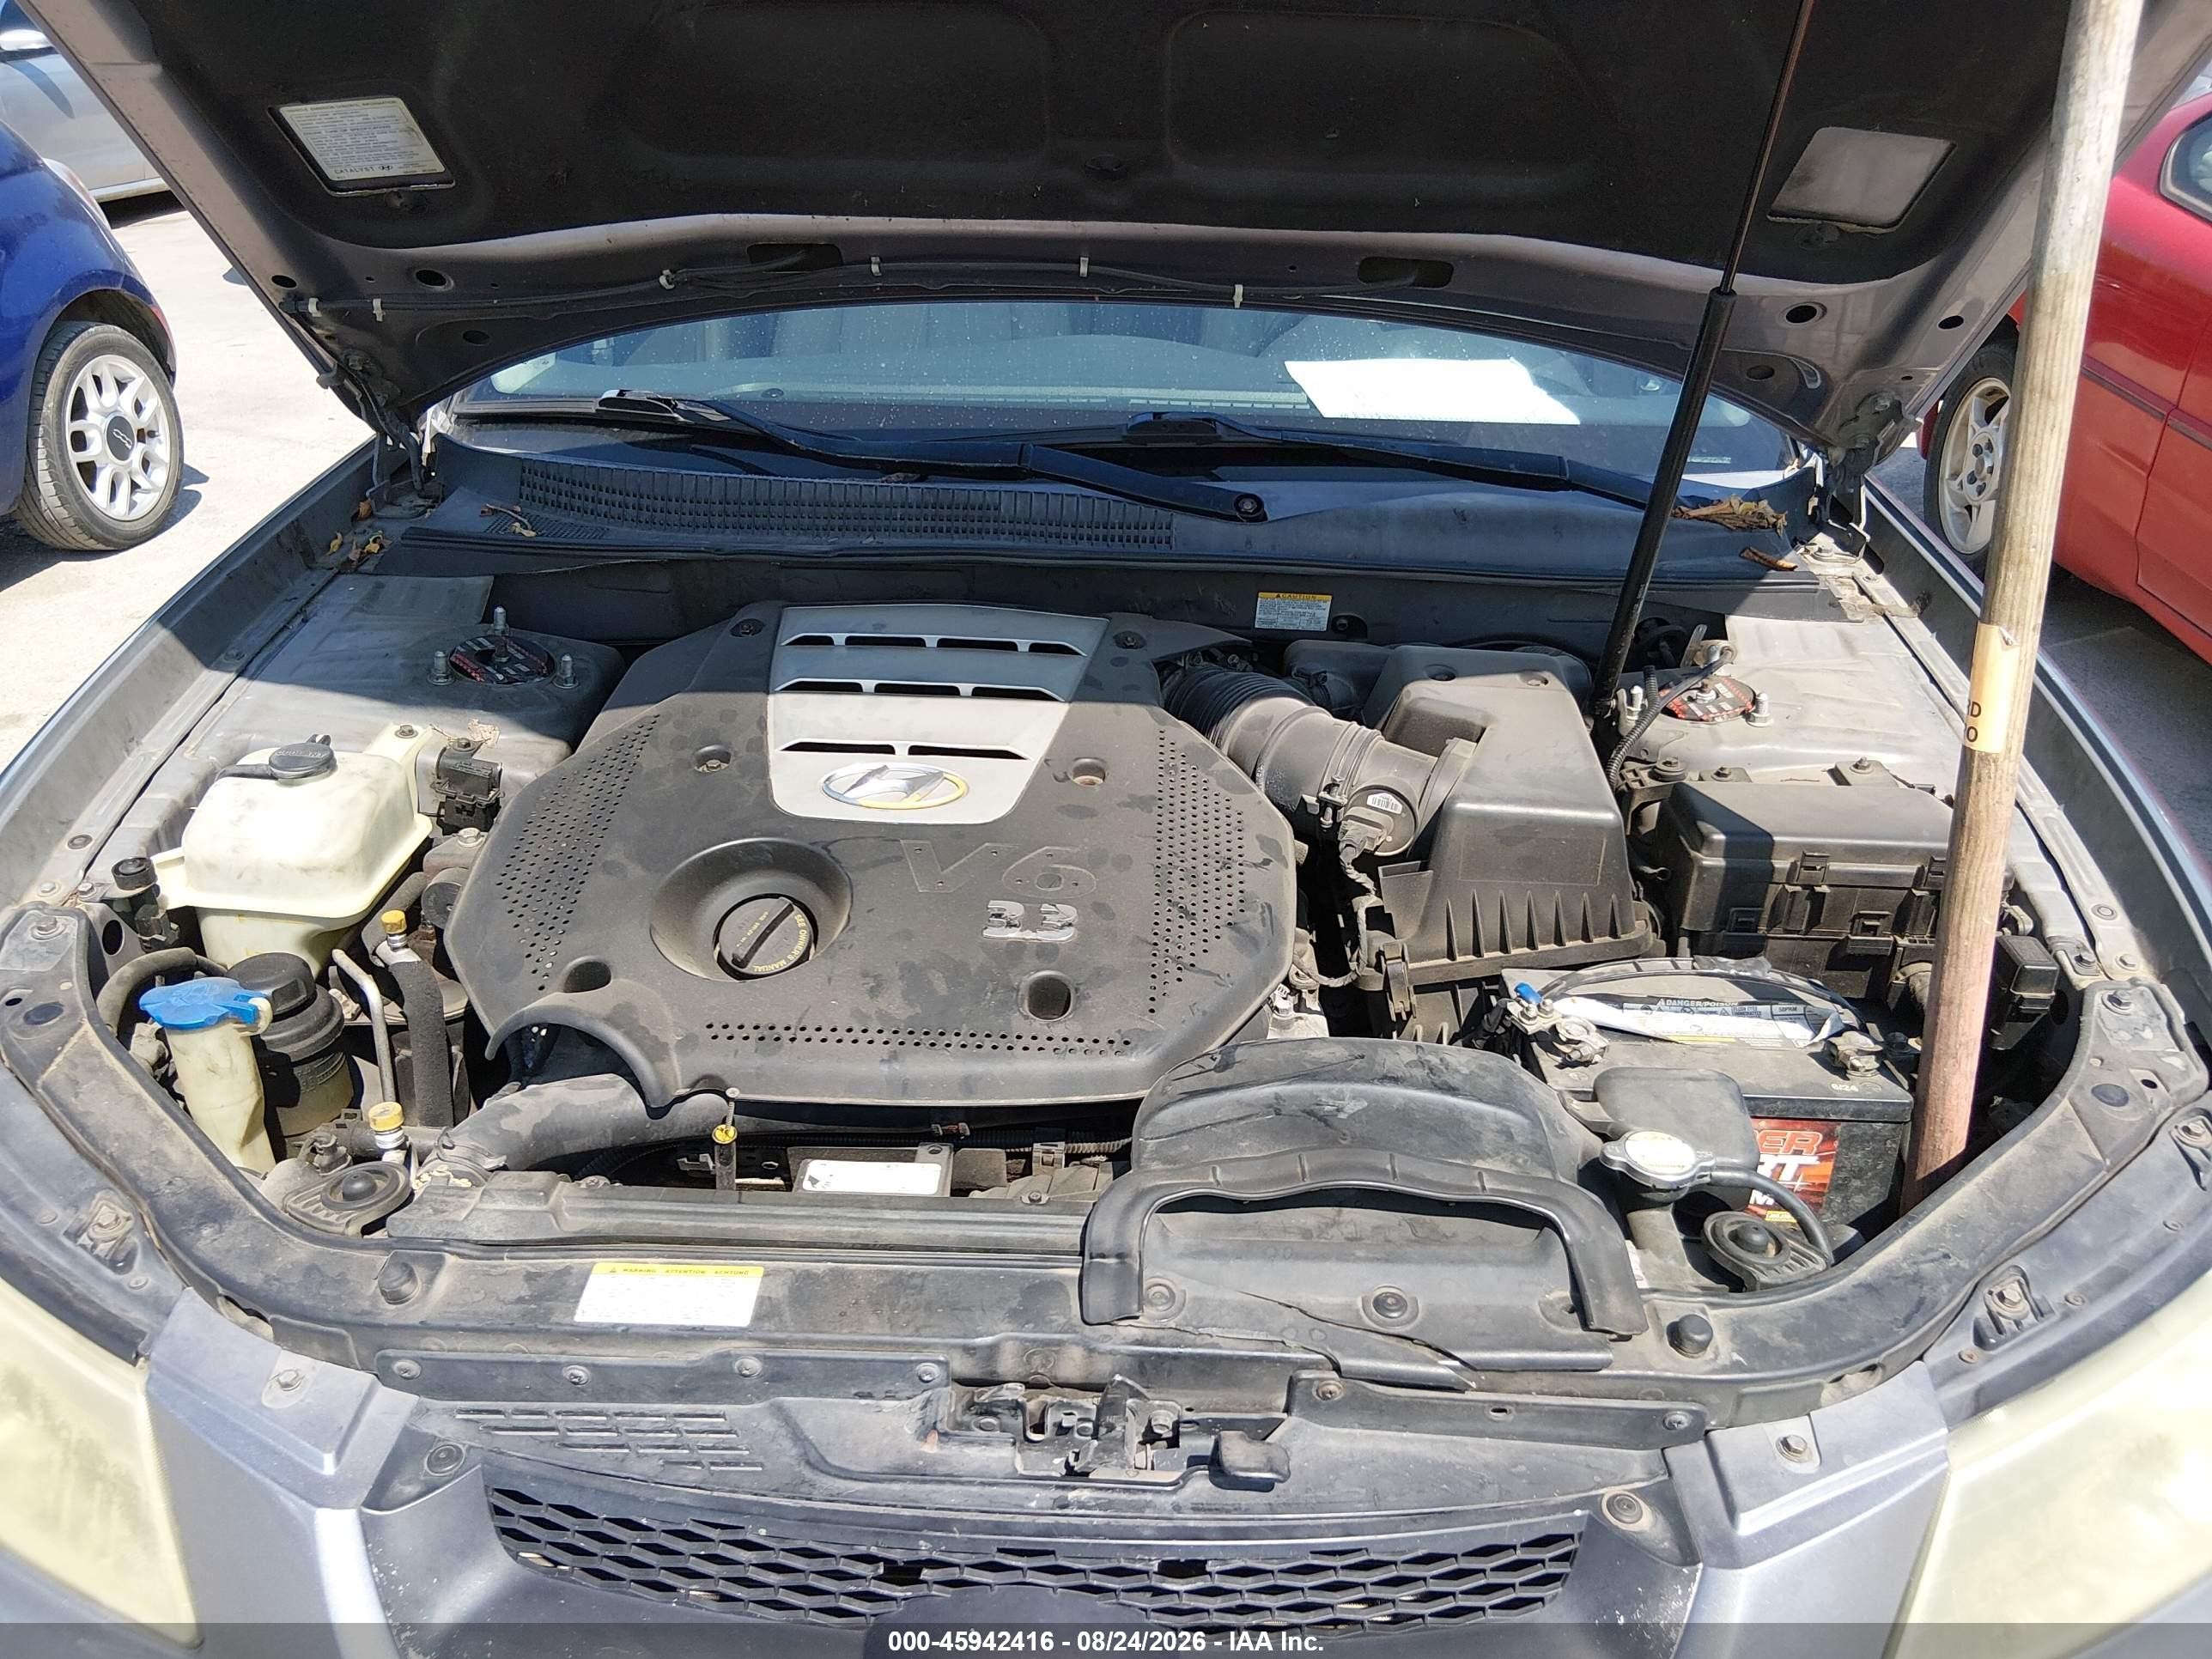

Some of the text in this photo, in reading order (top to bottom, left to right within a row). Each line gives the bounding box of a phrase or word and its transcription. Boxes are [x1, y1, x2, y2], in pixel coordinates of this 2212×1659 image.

[334, 166, 376, 175] CATALYST
[899, 838, 1098, 899] V6
[753, 914, 809, 973] SEE OWNER'S MANUAL
[1755, 1129, 1824, 1156] ER
